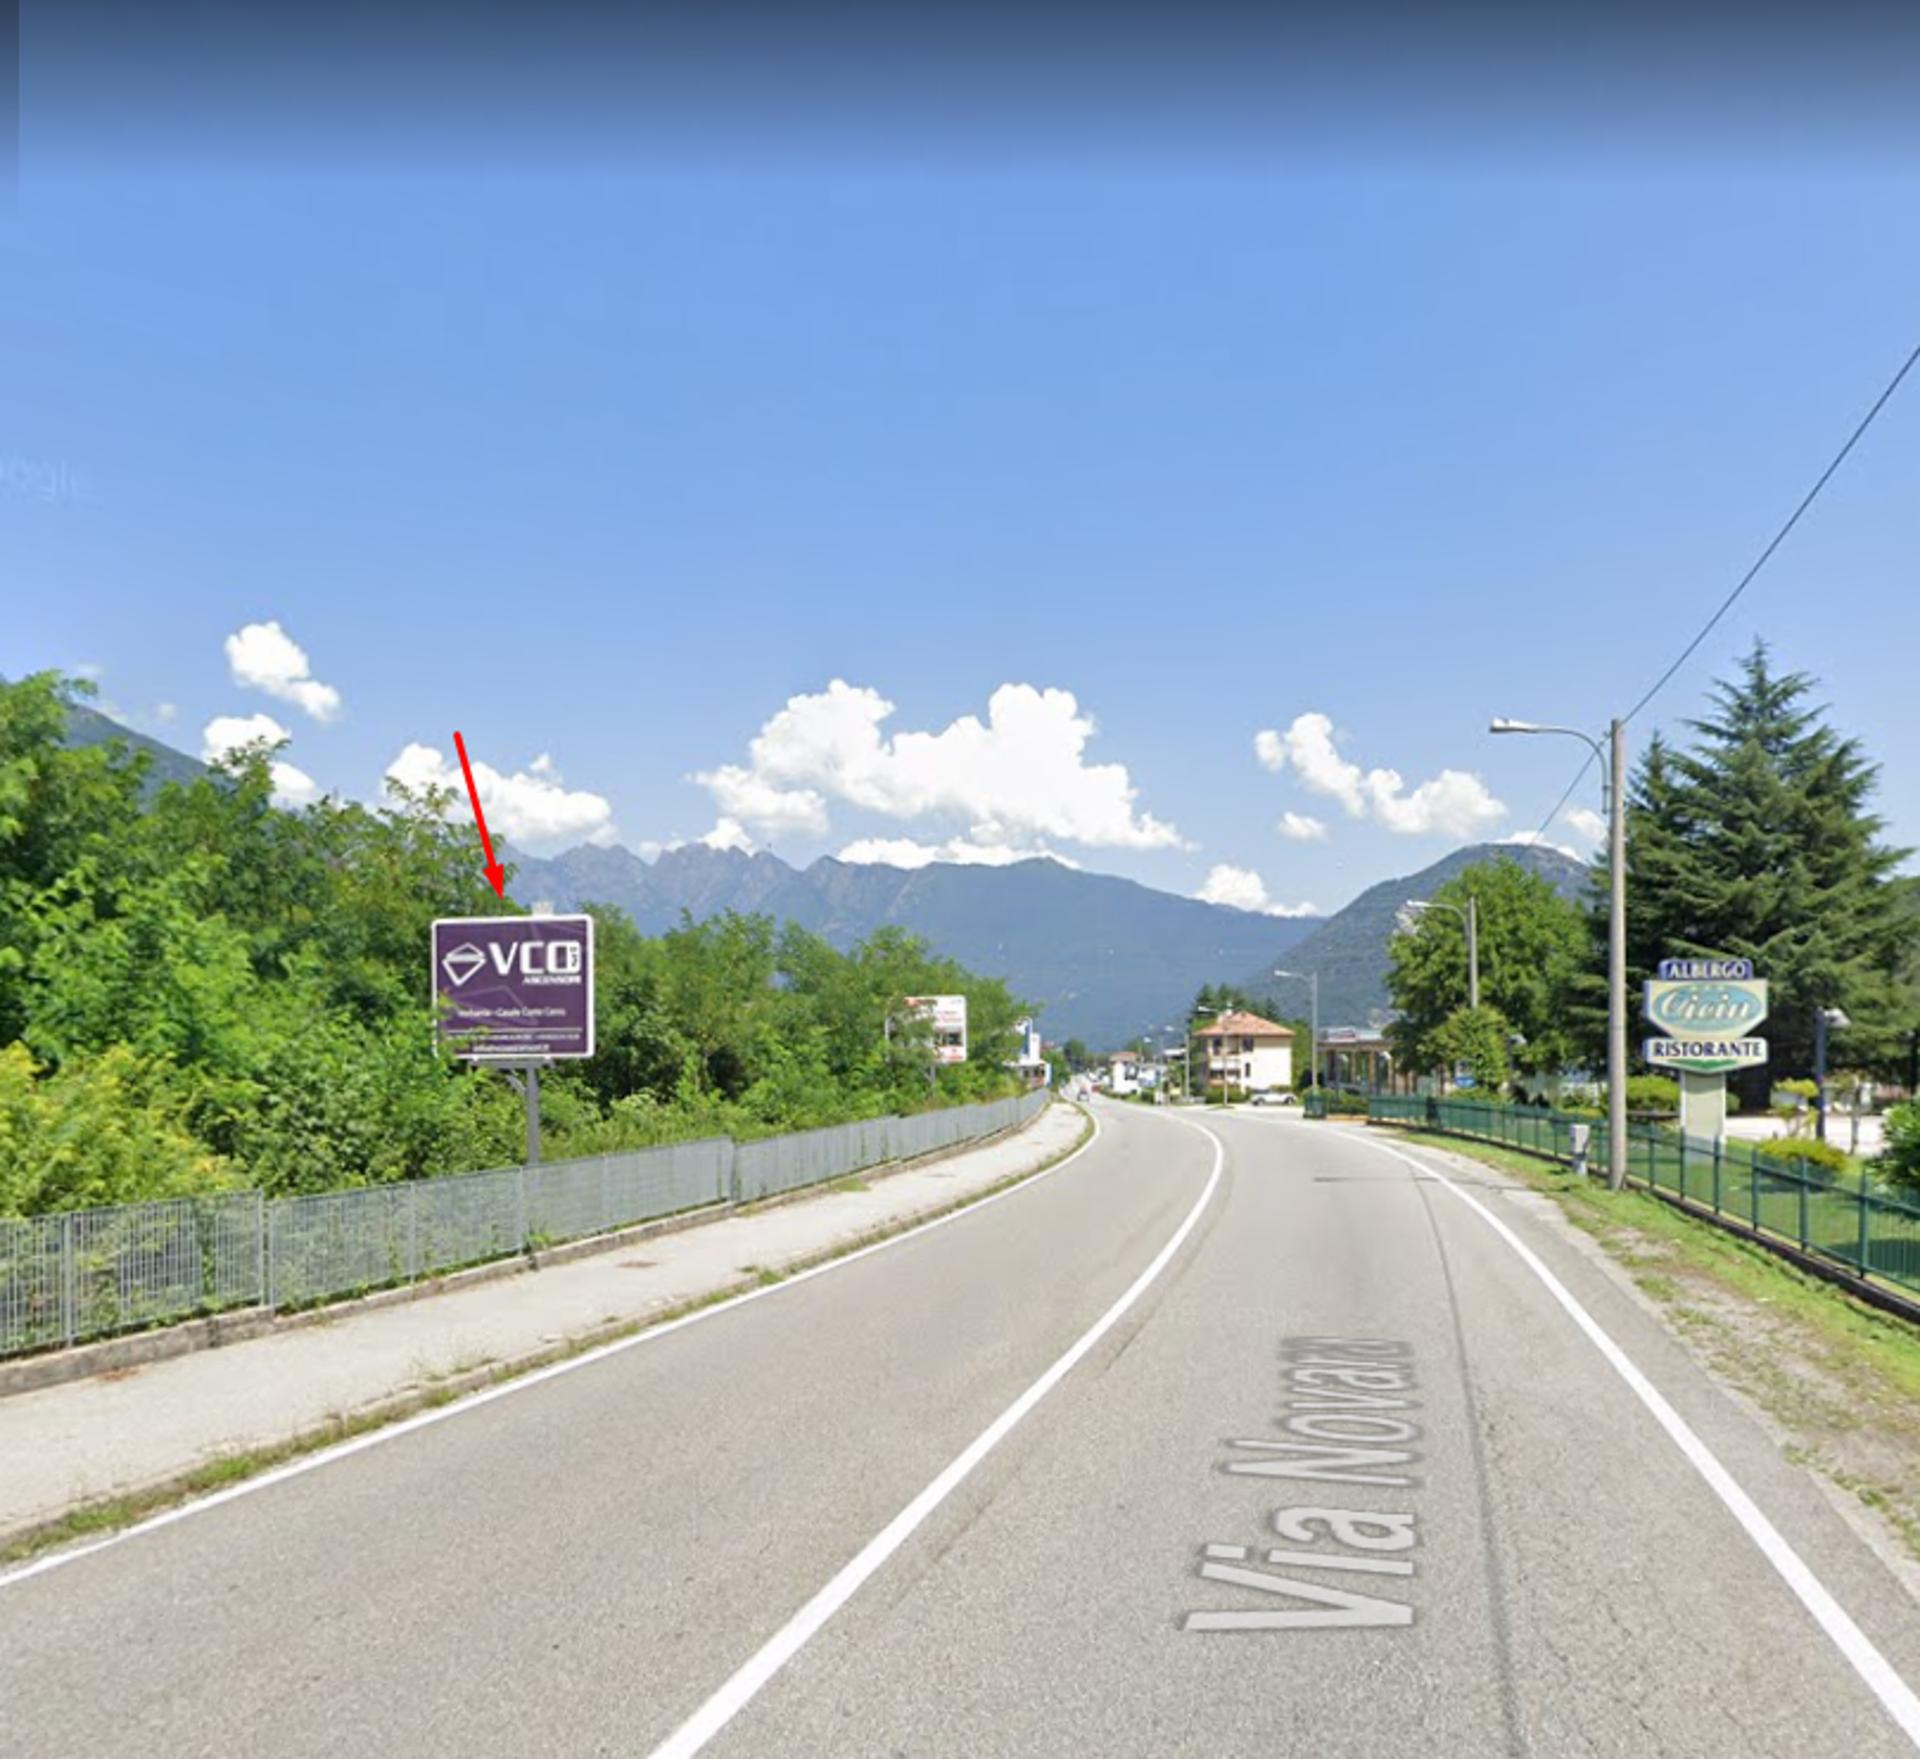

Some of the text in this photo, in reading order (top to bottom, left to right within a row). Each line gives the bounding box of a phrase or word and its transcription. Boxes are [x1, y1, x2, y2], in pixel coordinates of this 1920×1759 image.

[488, 940, 582, 976] VCO
[1668, 962, 1746, 978] ALBERGO
[1653, 1040, 1762, 1057] RISTORANTE
